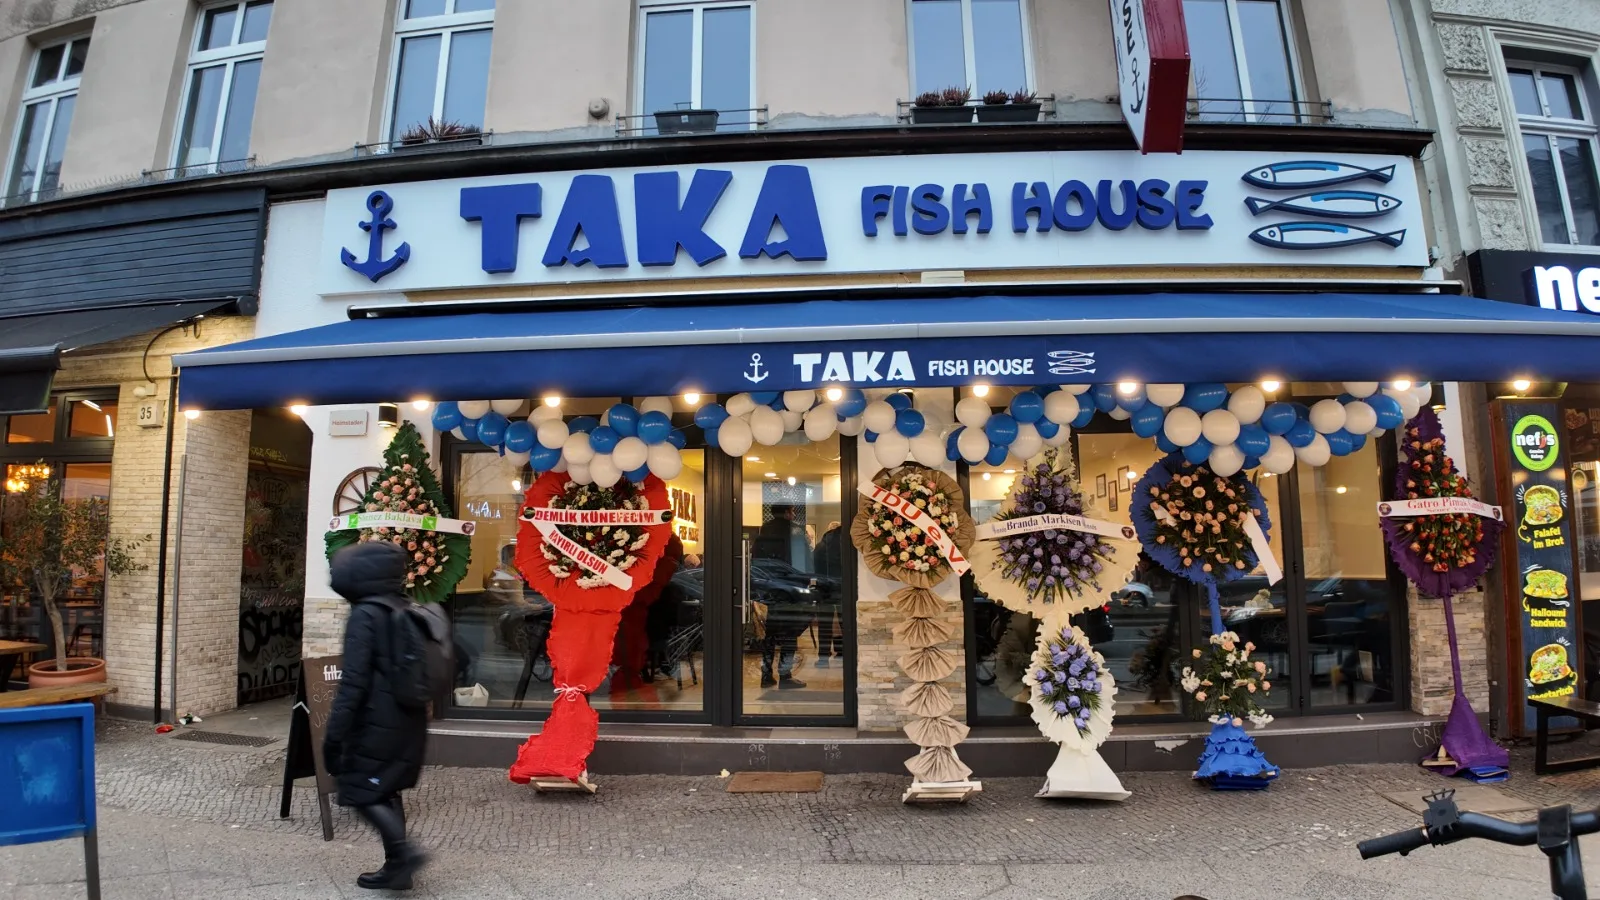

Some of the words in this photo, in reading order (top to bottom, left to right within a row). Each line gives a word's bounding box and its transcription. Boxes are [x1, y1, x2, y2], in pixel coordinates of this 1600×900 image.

[460, 165, 828, 274] TAKA
[861, 183, 993, 238] FISH
[1012, 178, 1215, 233] HOUSE
[793, 351, 916, 383] TAKA
[928, 359, 968, 377] FISH
[973, 358, 1035, 376] HOUSE
[140, 407, 153, 420] 35
[872, 485, 922, 520] TDU
[535, 509, 577, 523] DEMLİK
[1006, 517, 1039, 531] Branda
[1041, 515, 1082, 527] Markisen
[1533, 526, 1562, 539] Falafel
[1545, 536, 1565, 548] Brot
[577, 550, 609, 575] OLSUN
[1530, 607, 1567, 618] Halloumi
[1530, 618, 1567, 628] Sandwich
